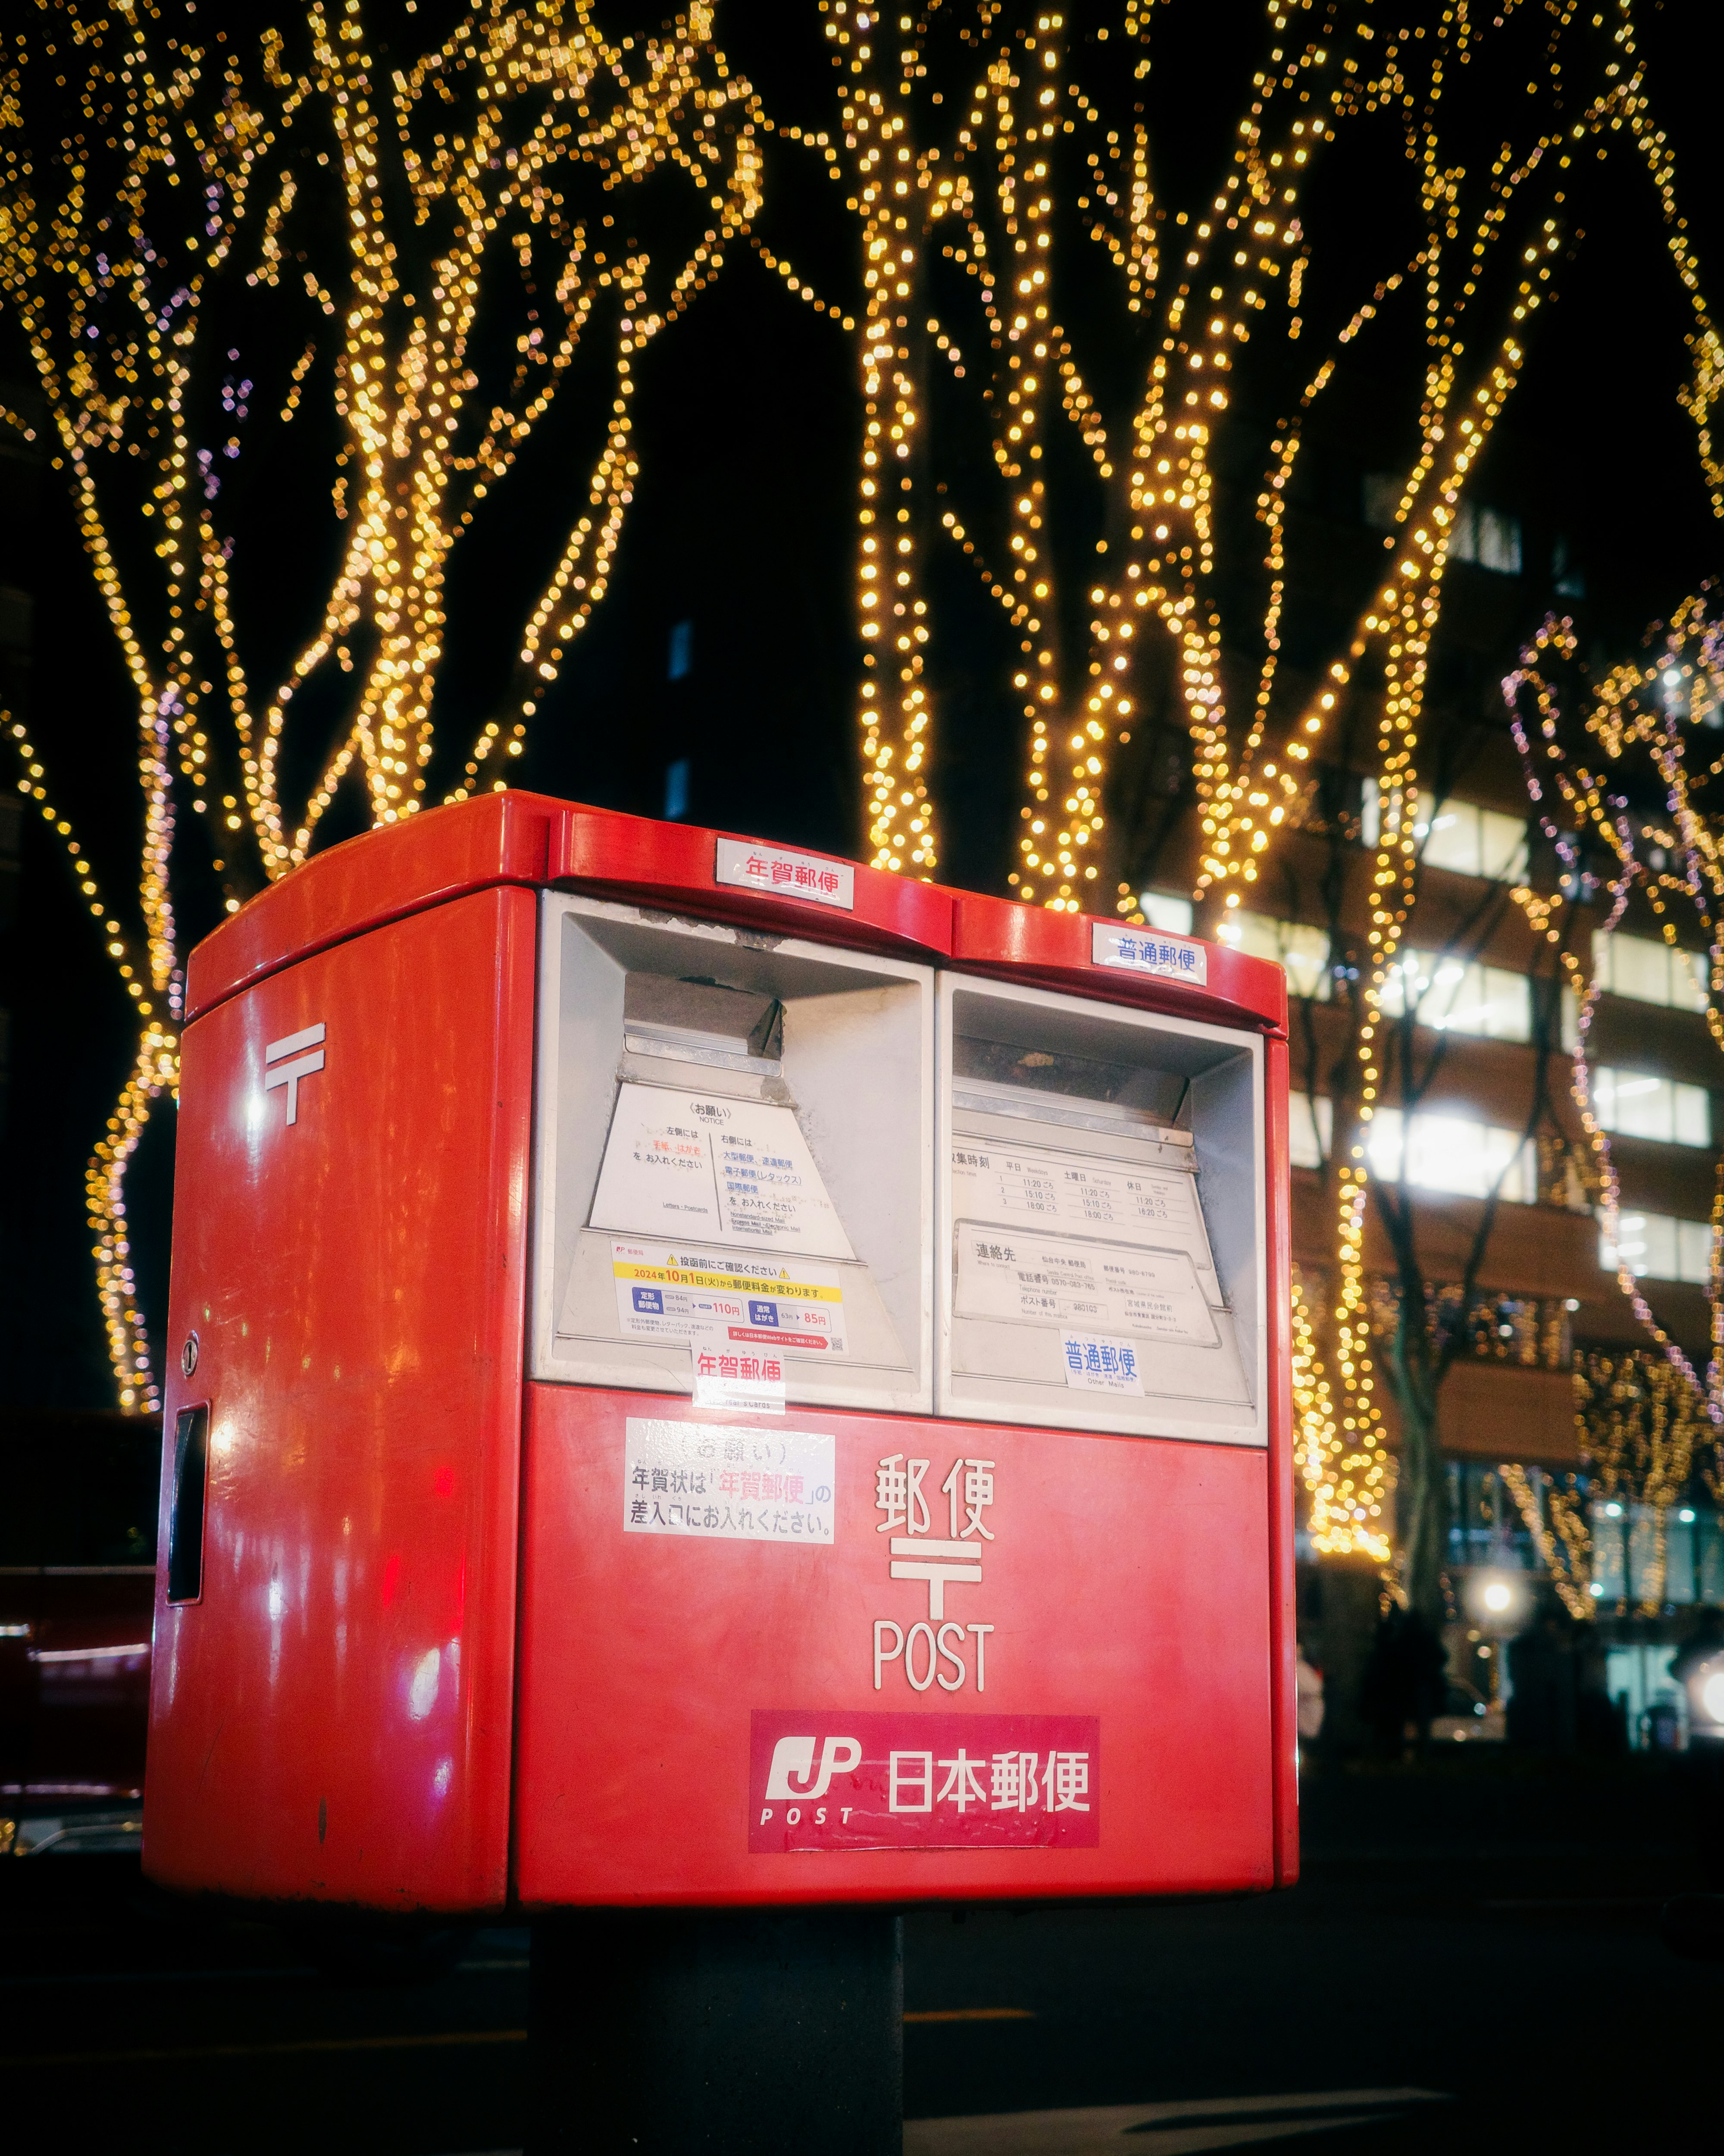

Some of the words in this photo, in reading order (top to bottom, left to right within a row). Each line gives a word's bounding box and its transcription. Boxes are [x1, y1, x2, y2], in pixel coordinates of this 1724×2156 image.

[745, 856, 839, 898] 年賀郵便
[1117, 937, 1195, 972] 普通郵便
[700, 1116, 724, 1125] NOTICE
[667, 1126, 699, 1138] 左側には
[721, 1134, 752, 1147] 右側には
[633, 1152, 641, 1160] を
[646, 1154, 702, 1169] お入れください
[1006, 1161, 1021, 1171] 平日
[1064, 1171, 1086, 1181] 土曜日
[727, 1181, 758, 1194] 国際郵便
[1023, 1178, 1041, 1188] 11:20
[1127, 1181, 1142, 1191] 休日
[1025, 1190, 1043, 1199] 15:10
[1080, 1188, 1098, 1197] 11:20
[729, 1196, 736, 1205] を
[742, 1197, 796, 1213] お入れください
[1027, 1201, 1044, 1210] 18:00
[1083, 1199, 1099, 1208] 15:10
[1136, 1197, 1153, 1206] 11:20
[730, 1211, 773, 1222] Nonstandard-sized
[1084, 1210, 1101, 1219] 18:00
[976, 1243, 1016, 1262] 連絡先
[680, 1256, 777, 1276] 投函前にご確認ください
[1042, 1256, 1066, 1266] 仙台中央
[1068, 1259, 1086, 1269] 郵便局
[1018, 1272, 1048, 1285] 電話番号
[641, 1291, 655, 1300] 定形
[1019, 1285, 1040, 1293] Telephone
[638, 1300, 659, 1310] 郵便物
[1021, 1295, 1056, 1309] ポスト番号
[713, 1302, 740, 1316] 110円
[757, 1305, 770, 1313] 通常
[755, 1313, 774, 1323] はがき
[804, 1313, 826, 1326] 85円
[1065, 1340, 1137, 1377] 普通郵便
[698, 1352, 781, 1381] 年賀郵便
[632, 1466, 831, 1504] 年賀状は「年賀郵便」の
[876, 1454, 995, 1540] 郵便
[630, 1499, 829, 1536] 差入口にお入れください。
[874, 1620, 994, 1692] POST
[889, 1748, 1090, 1812] 日本郵便
[760, 1807, 853, 1825] POST
